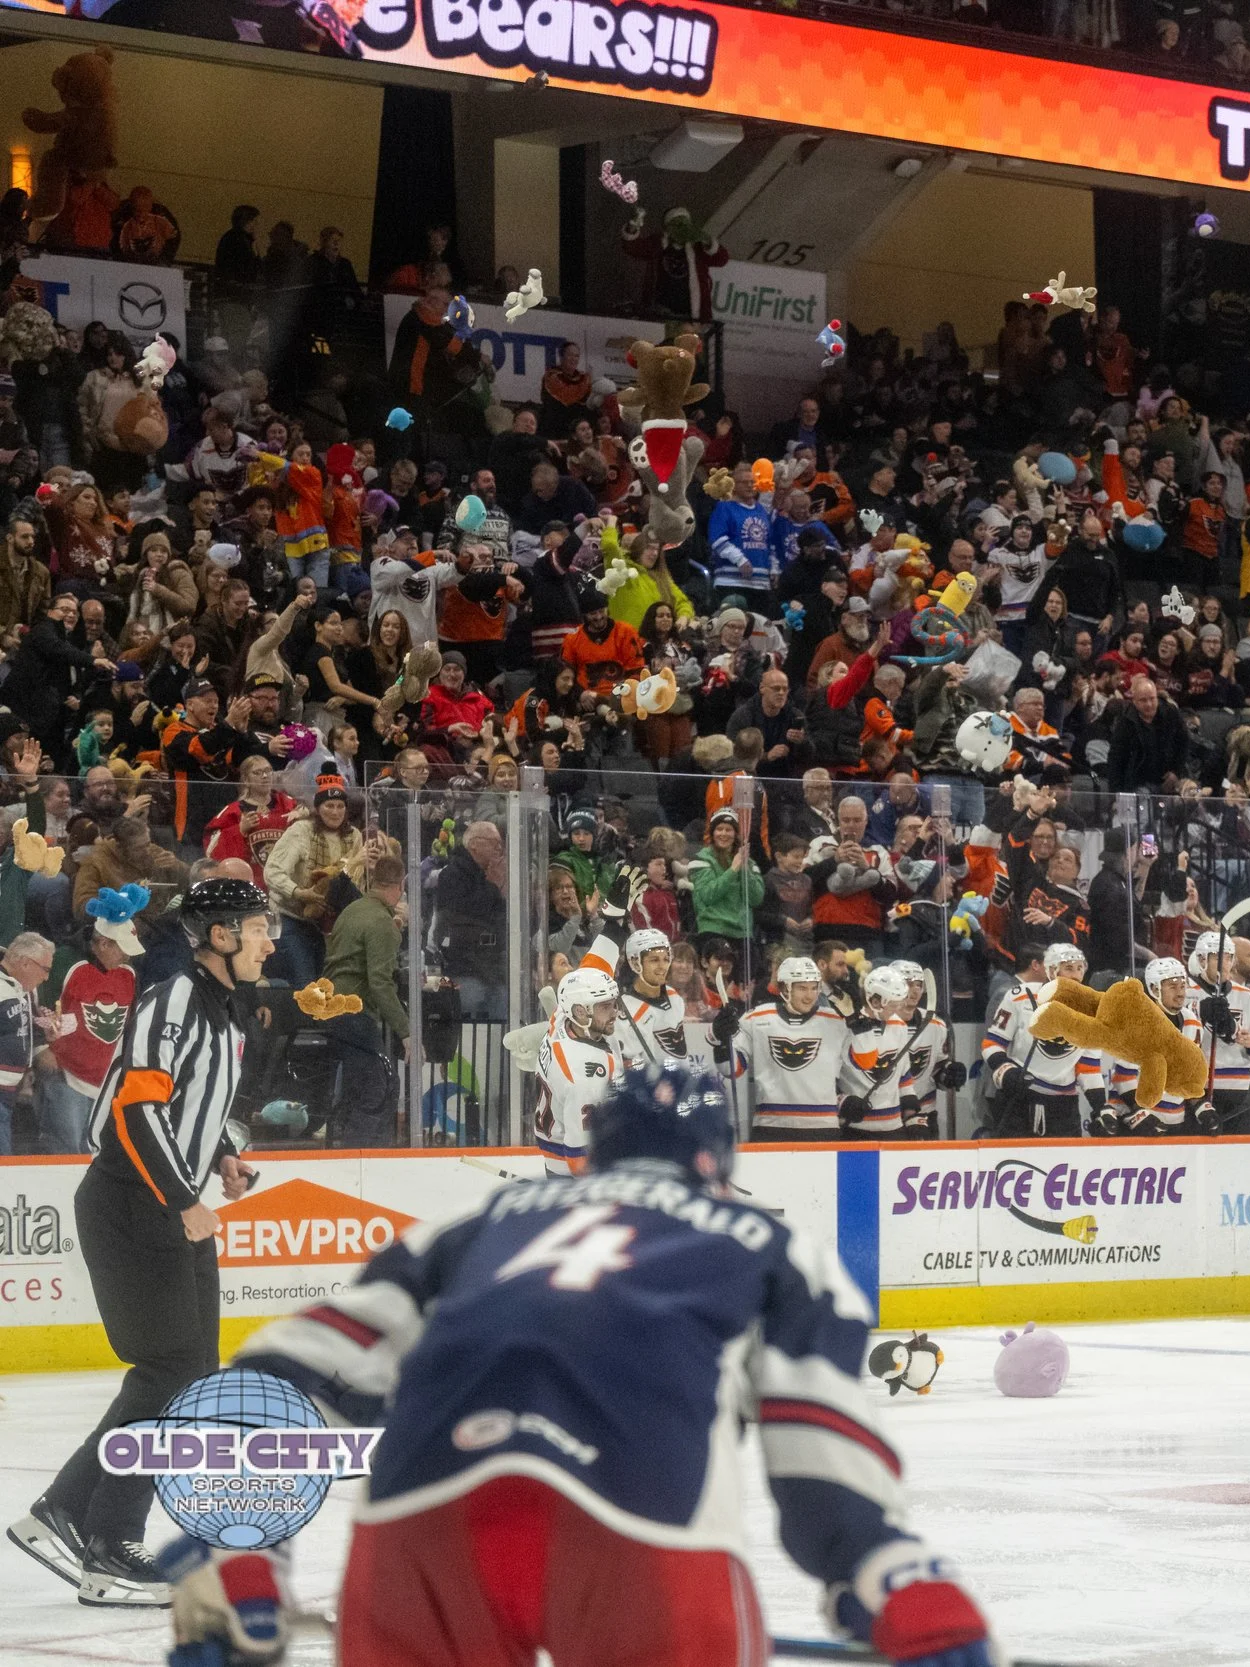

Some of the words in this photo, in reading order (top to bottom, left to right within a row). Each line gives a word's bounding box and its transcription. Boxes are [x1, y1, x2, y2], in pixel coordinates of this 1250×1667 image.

[747, 240, 815, 266] 105
[711, 281, 819, 324] UniFirst
[161, 1023, 183, 1044] 42
[892, 1166, 1034, 1215] SERVICE
[1043, 1163, 1187, 1211] ELECTRIC
[495, 1202, 638, 1292] 4
[923, 1252, 973, 1270] CABLE
[979, 1250, 999, 1269] TV
[1001, 1249, 1013, 1268] &
[242, 1283, 329, 1301] Restoration.
